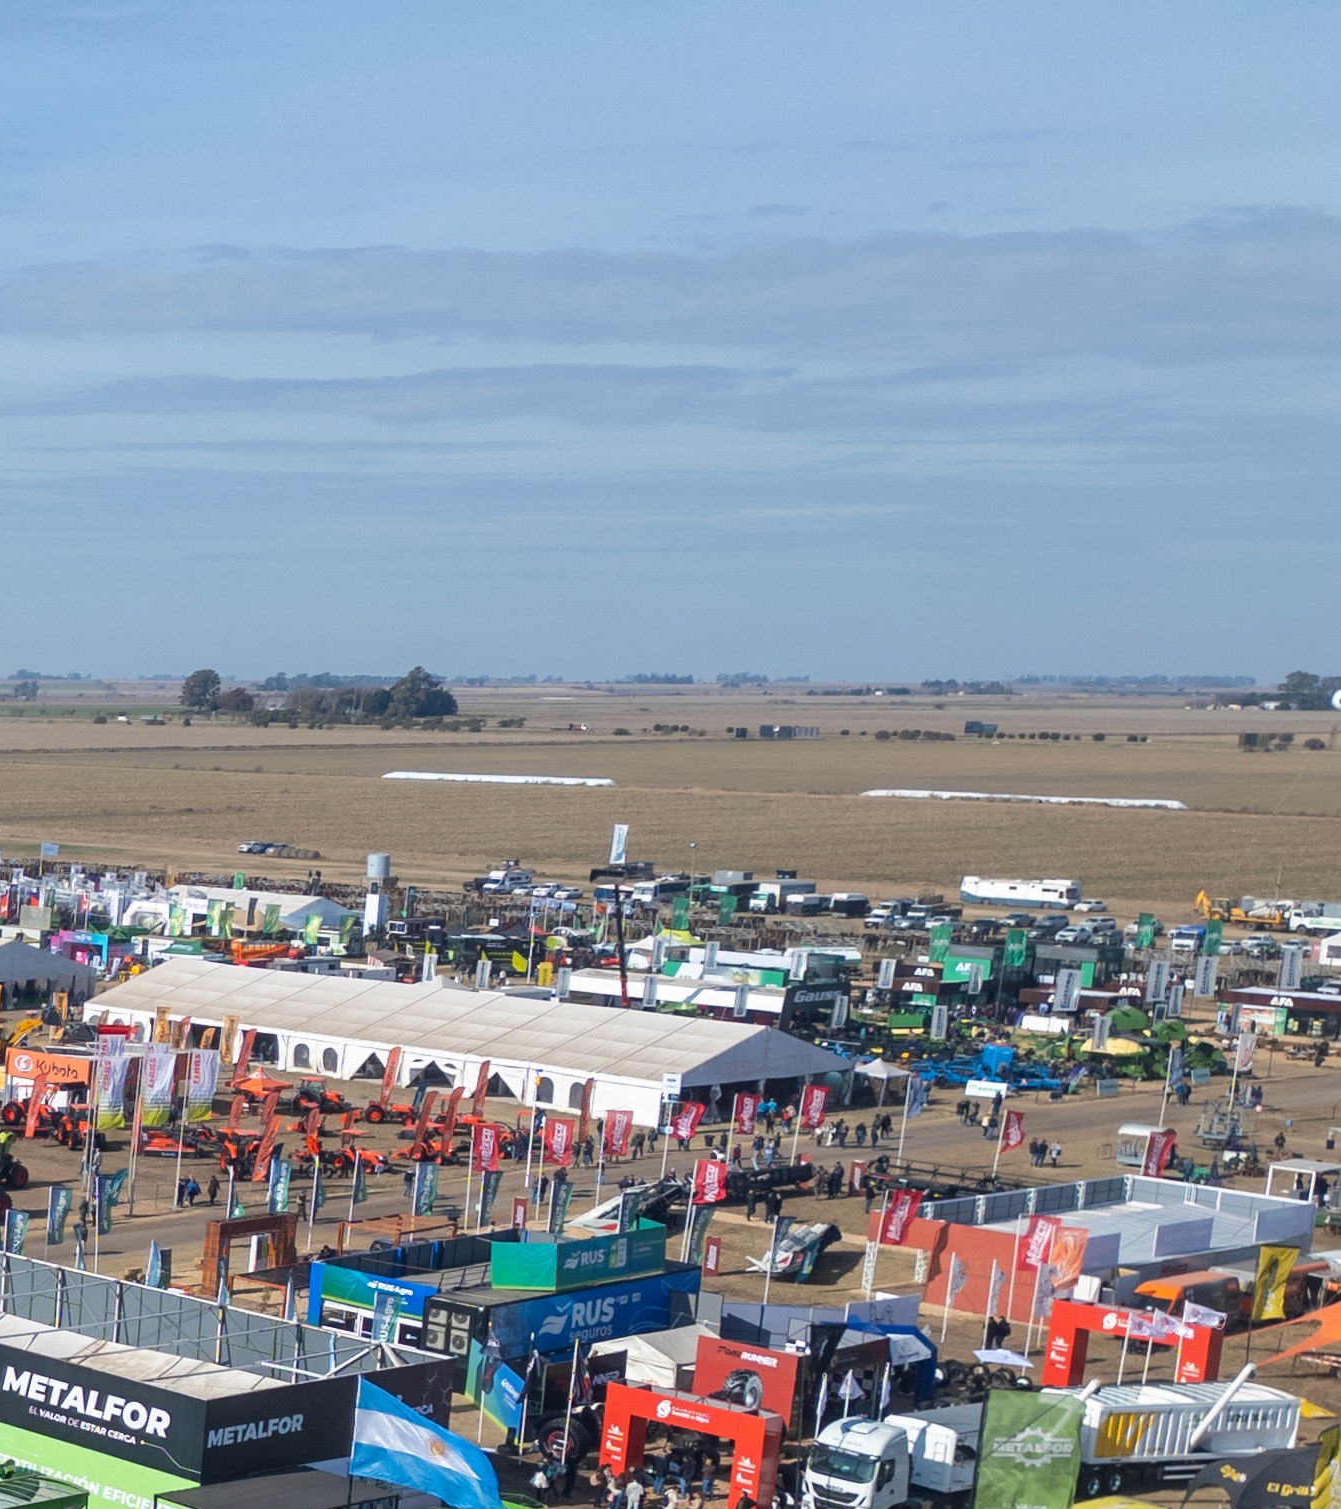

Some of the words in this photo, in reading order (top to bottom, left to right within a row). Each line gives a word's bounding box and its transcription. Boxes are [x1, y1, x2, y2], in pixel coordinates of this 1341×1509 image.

[914, 968, 935, 977] AFA
[902, 982, 923, 992] AFA
[1118, 986, 1141, 998] AFA
[794, 989, 842, 1004] Gauss
[1270, 996, 1294, 1008] AFA
[36, 1059, 79, 1080] Kubota
[1025, 1221, 1054, 1267] Maizco
[580, 1249, 605, 1266] RUS
[571, 1297, 615, 1328] RUS
[569, 1324, 614, 1344] seguros
[2, 1366, 172, 1438] METALFOR
[28, 1405, 39, 1416] EL
[39, 1409, 67, 1424] VALOR
[68, 1417, 80, 1428] DE
[80, 1421, 107, 1436] ESTAR
[108, 1428, 136, 1445] CERCA
[207, 1413, 304, 1448] METALFOR
[992, 1442, 1074, 1455] METALFOR
